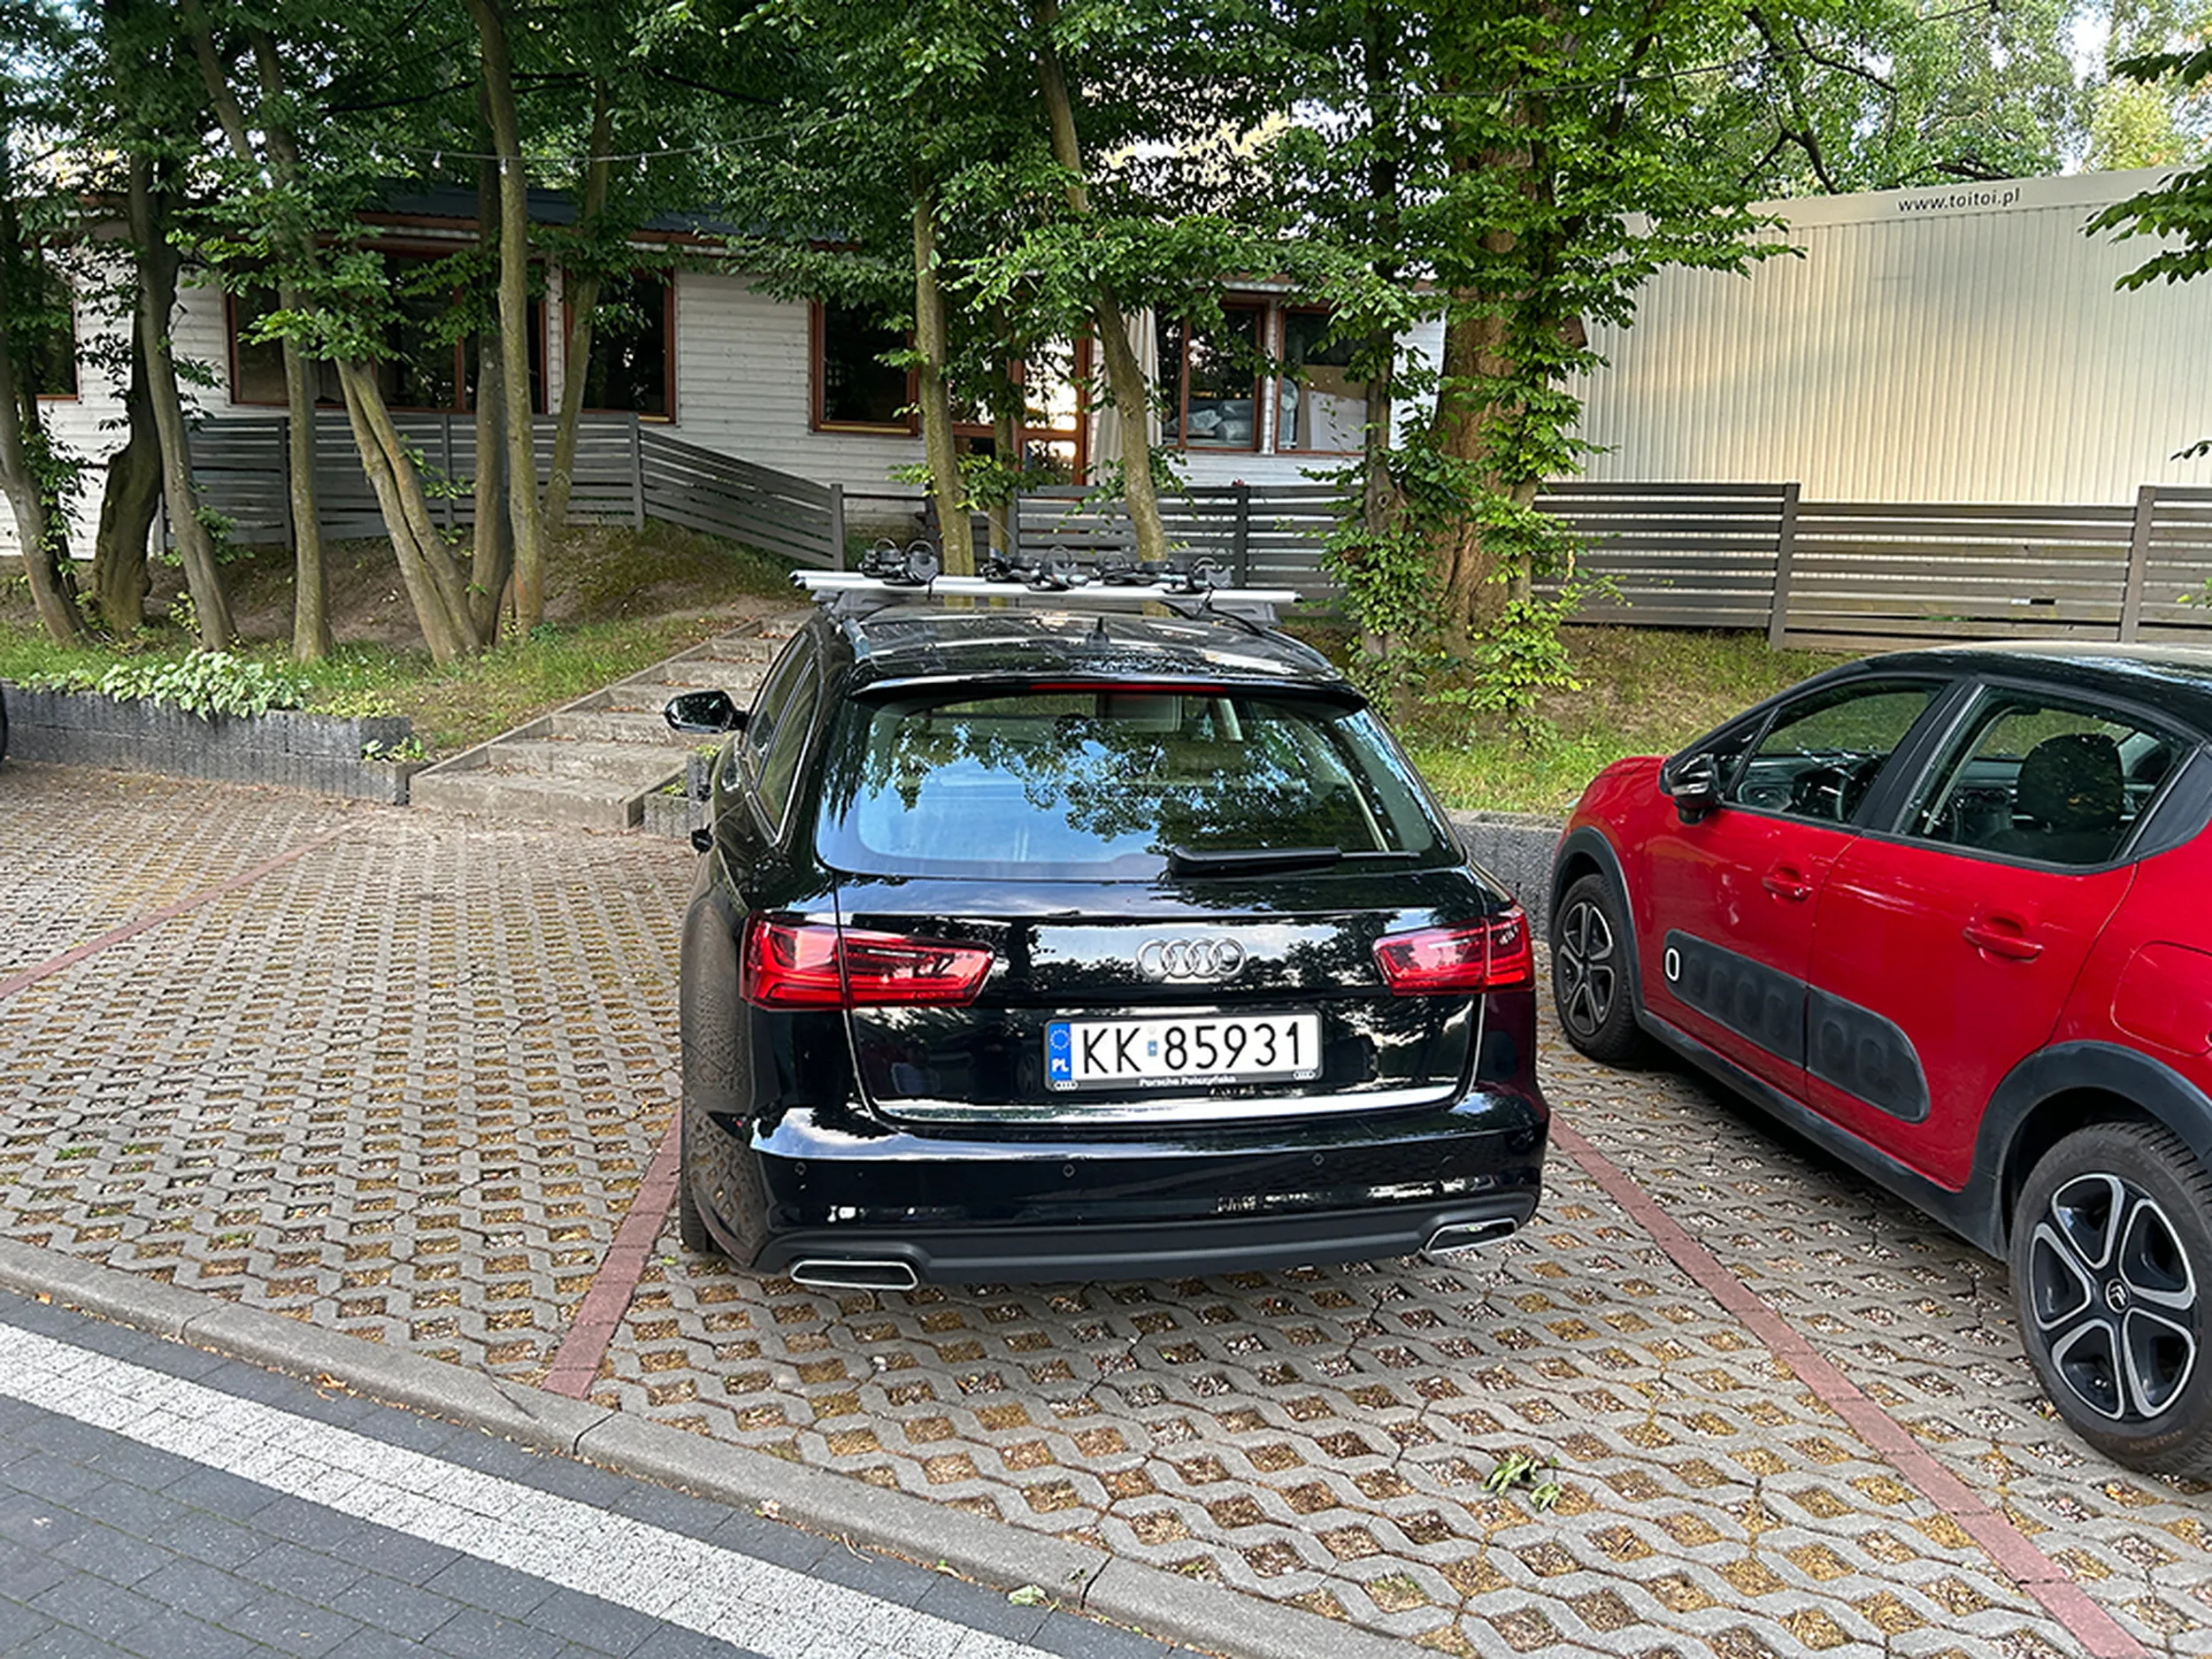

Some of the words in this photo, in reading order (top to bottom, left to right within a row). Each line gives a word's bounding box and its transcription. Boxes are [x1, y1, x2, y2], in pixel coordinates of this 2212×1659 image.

[1898, 188, 2021, 211] www.toitoi.pl
[1082, 1027, 1142, 1074] KK
[1164, 1021, 1300, 1071] 85931
[1052, 1057, 1069, 1072] PL
